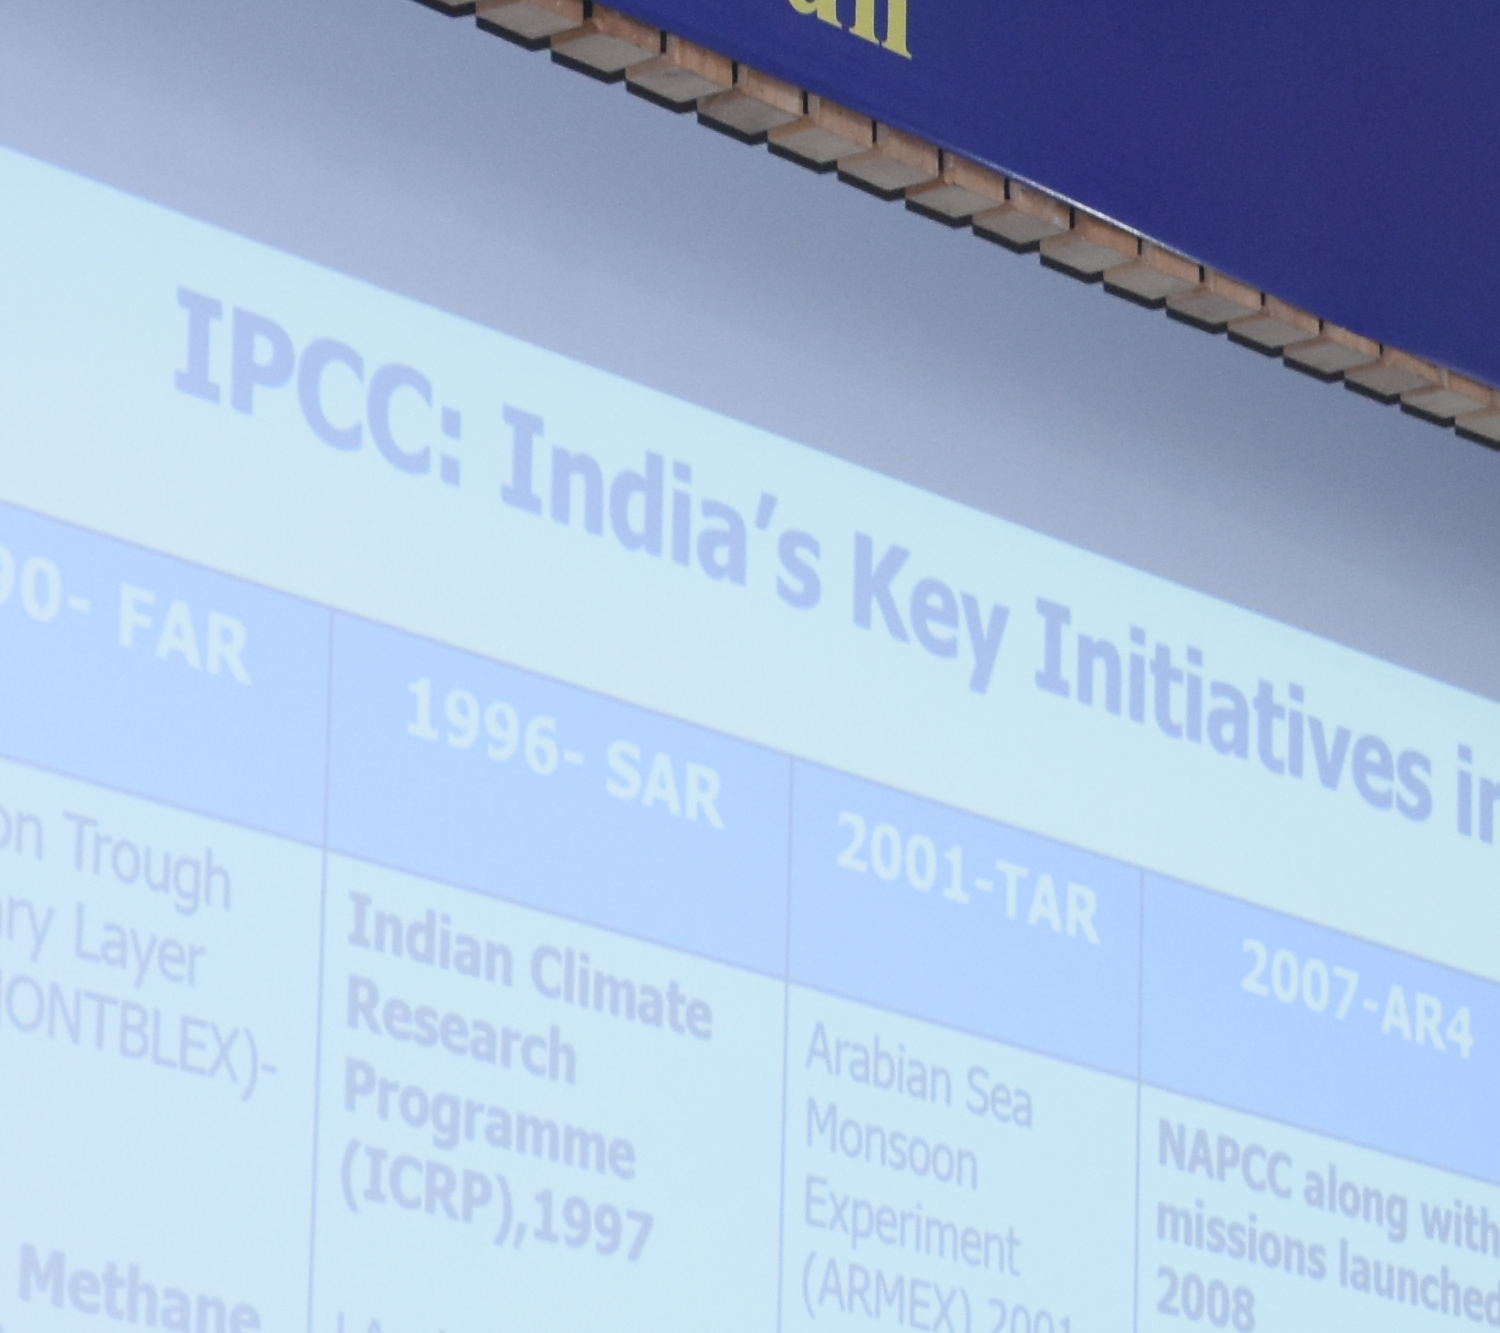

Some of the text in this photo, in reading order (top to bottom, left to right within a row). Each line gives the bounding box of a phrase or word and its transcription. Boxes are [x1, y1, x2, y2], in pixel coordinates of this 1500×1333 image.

[174, 286, 462, 487] IPCC:
[853, 531, 1010, 694] Key
[1036, 599, 1432, 821] Initiatives
[119, 583, 251, 684] FAR
[407, 677, 724, 829] 1996- SAR
[62, 810, 232, 917] Trough
[836, 811, 1100, 944] 2001-TAR
[74, 901, 207, 989] Layer
[348, 890, 713, 1041] Indian Climate
[1241, 938, 1474, 1058] 2007-AR4
[346, 974, 577, 1085] Research
[804, 1020, 1034, 1129] Arabian Sea
[344, 1057, 636, 1181] Programme
[805, 1096, 979, 1190] Monsoon
[803, 1173, 1022, 1278] Experiment
[1156, 1199, 1328, 1281] missions
[1158, 1118, 1500, 1258] NAPCC along with
